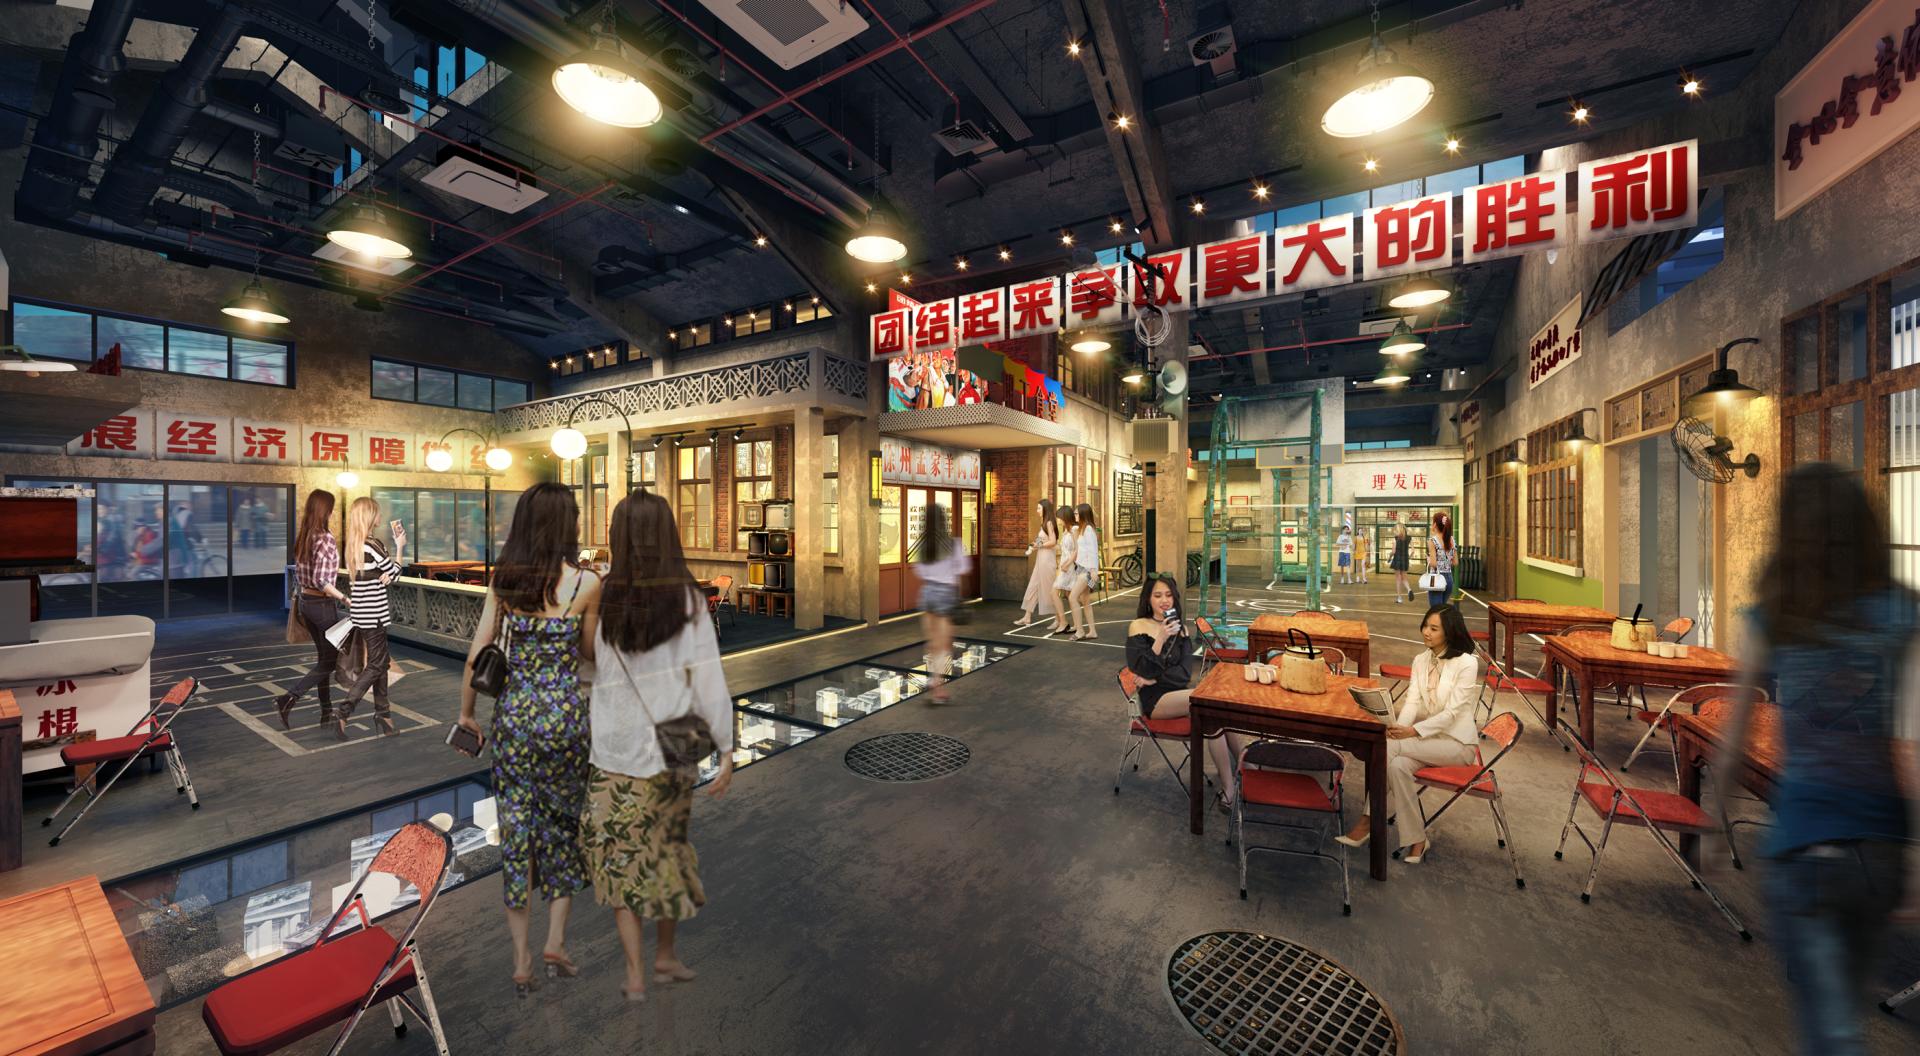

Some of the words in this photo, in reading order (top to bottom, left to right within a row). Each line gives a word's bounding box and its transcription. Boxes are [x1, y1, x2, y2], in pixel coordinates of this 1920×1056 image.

[874, 146, 1689, 354] 团结起来争取更大的胜利
[1372, 473, 1427, 490] 理发店
